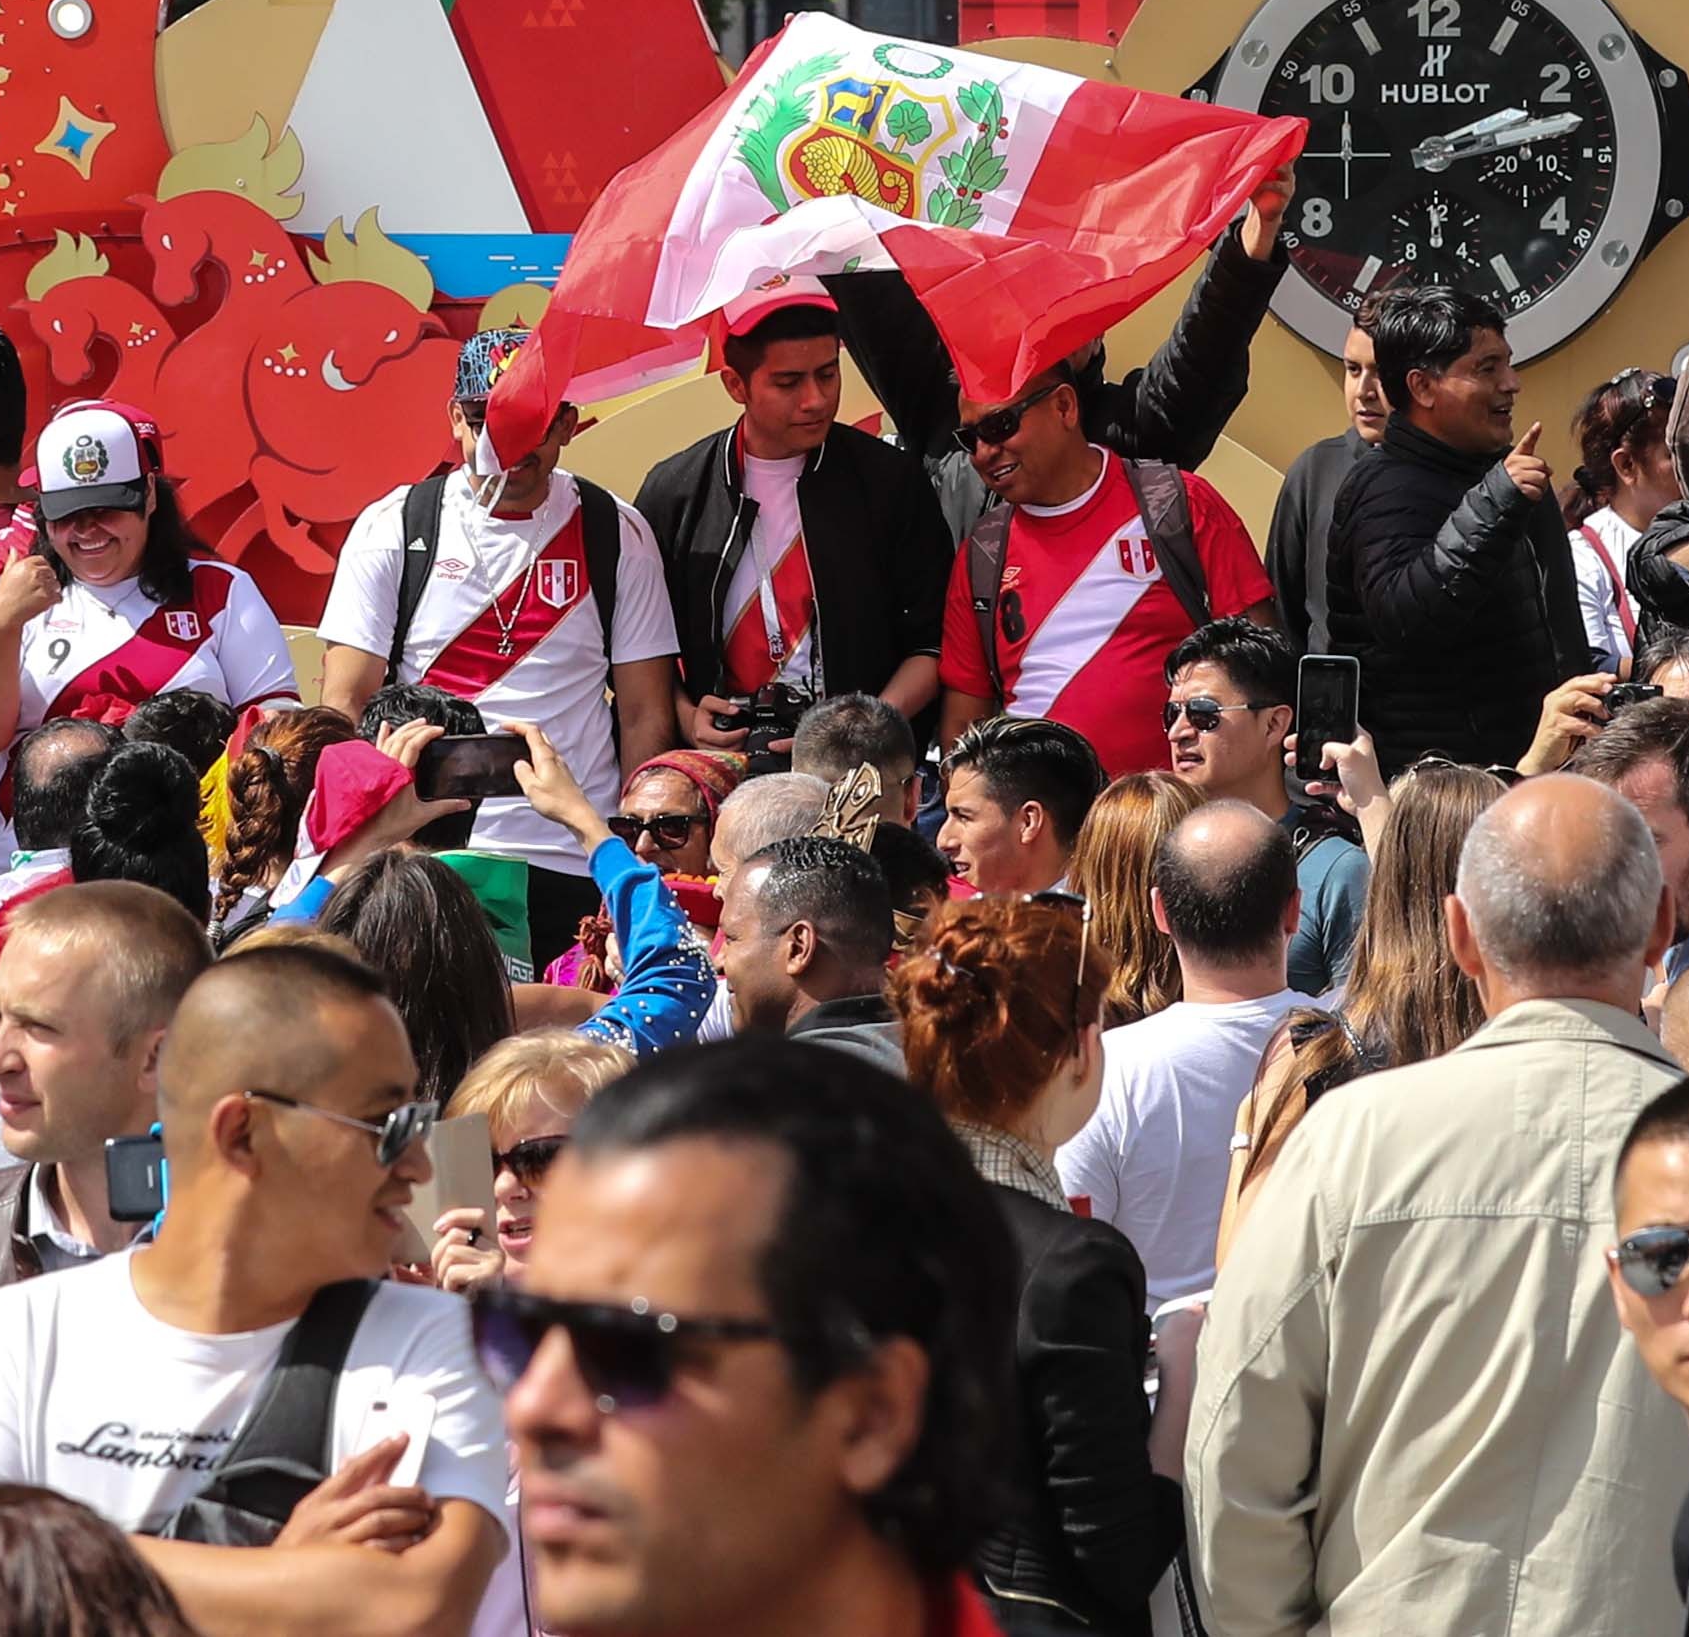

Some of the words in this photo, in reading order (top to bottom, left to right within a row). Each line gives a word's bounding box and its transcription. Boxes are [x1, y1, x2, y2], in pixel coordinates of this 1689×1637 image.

[1342, 0, 1362, 17] 55
[1511, 0, 1531, 17] 05
[1280, 60, 1299, 81] 50
[1576, 61, 1592, 80] 10
[1299, 64, 1355, 104] 10
[1539, 63, 1572, 104] 2
[1381, 84, 1491, 104] HUBLOT
[1535, 155, 1558, 172] 10
[1598, 146, 1612, 163] 15
[1495, 156, 1518, 173] 20
[1300, 197, 1333, 238] 8
[1539, 196, 1571, 235] 4
[1573, 228, 1592, 249] 20
[1405, 243, 1417, 260] 8
[1456, 242, 1468, 258] 4
[1342, 291, 1363, 310] 35
[1511, 290, 1531, 309] 25
[436, 572, 465, 580] umbro
[999, 590, 1026, 644] 8
[47, 637, 72, 675] 9
